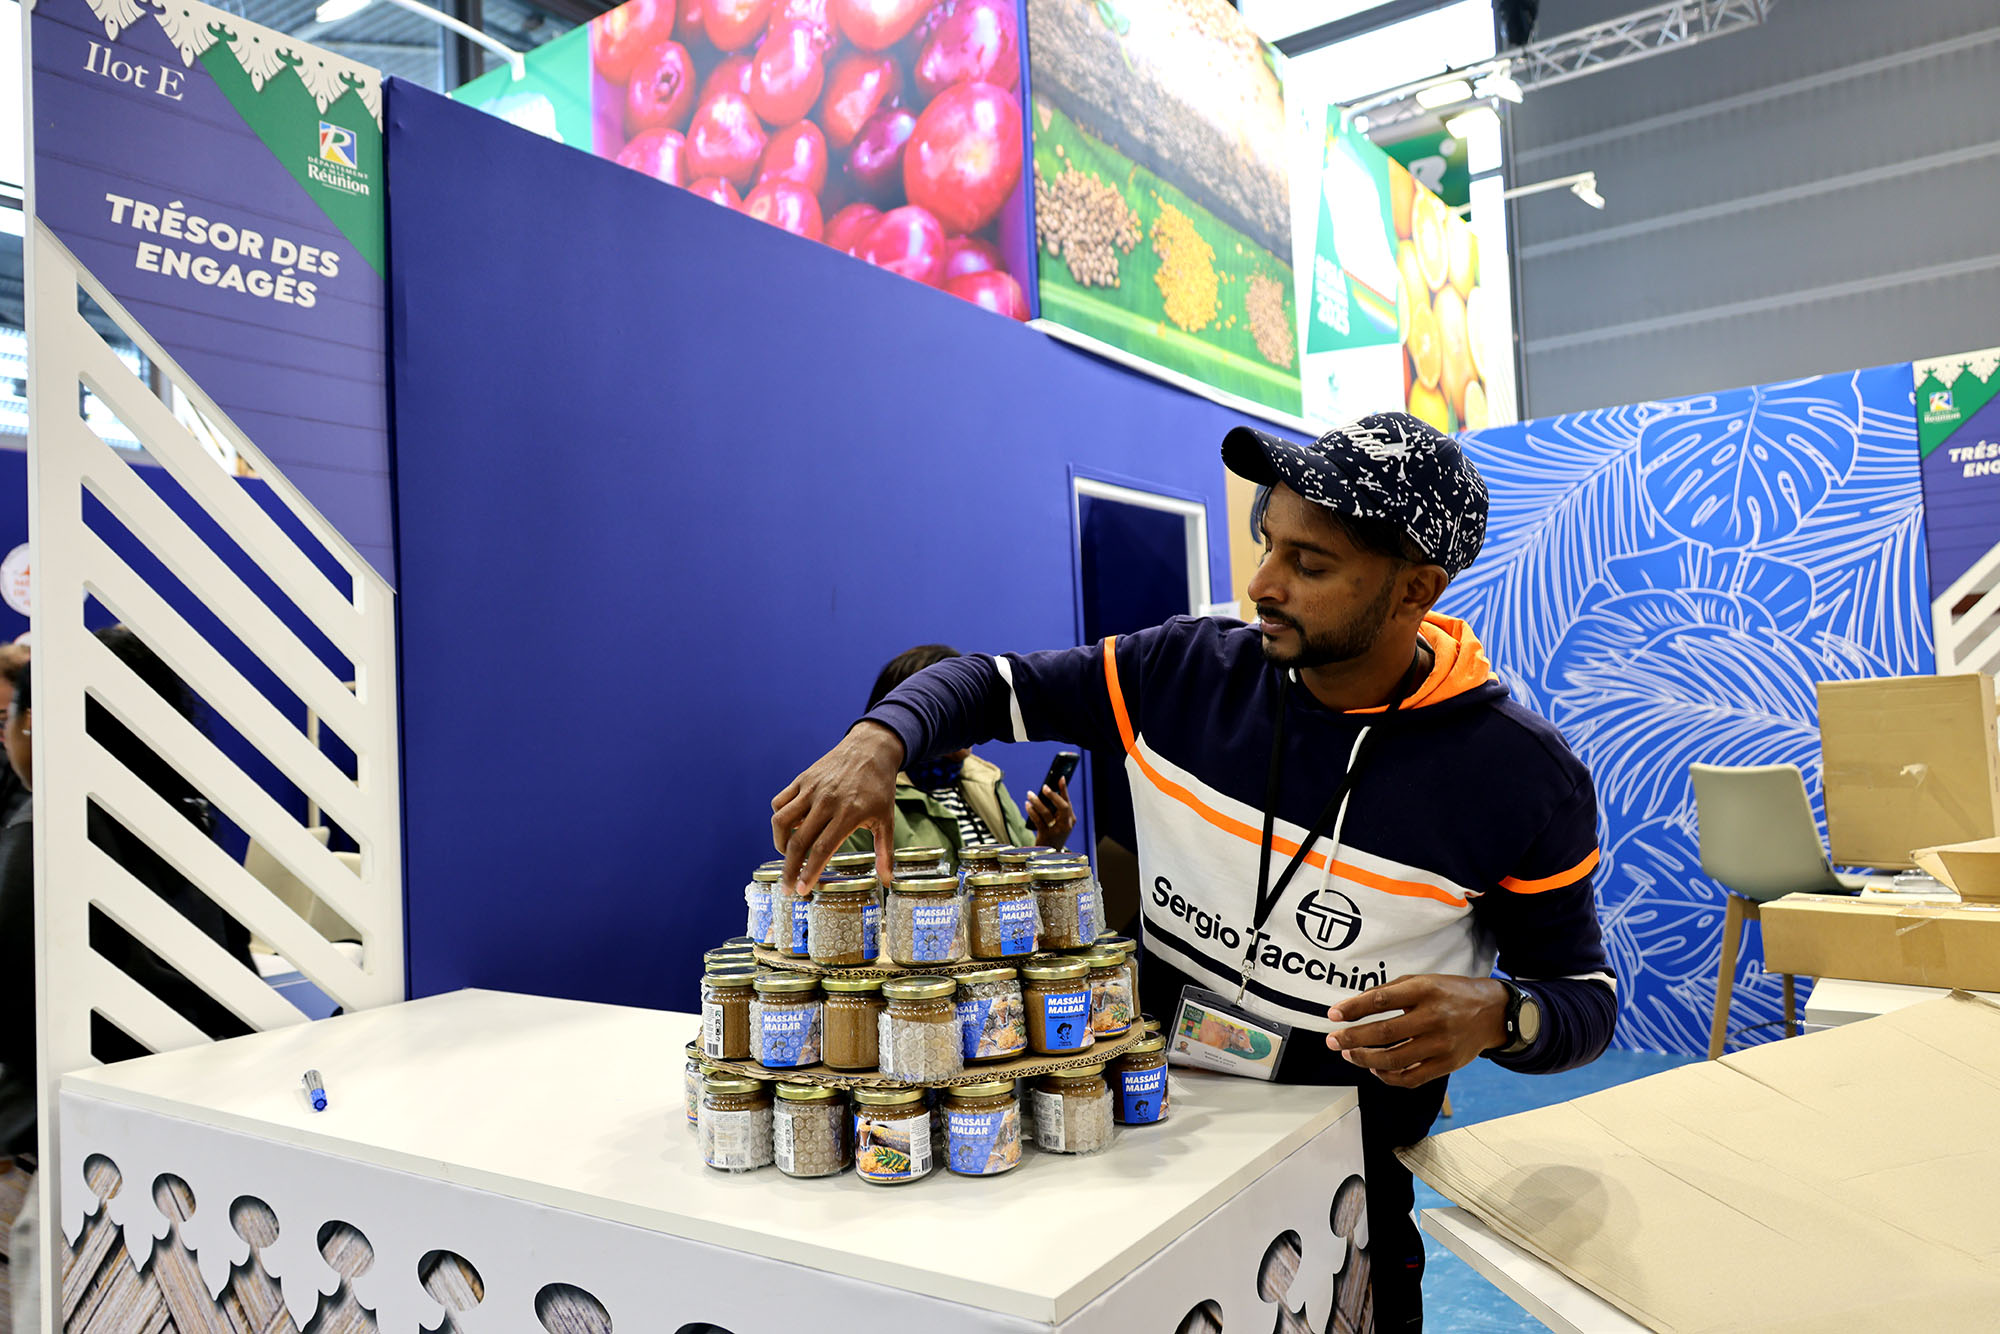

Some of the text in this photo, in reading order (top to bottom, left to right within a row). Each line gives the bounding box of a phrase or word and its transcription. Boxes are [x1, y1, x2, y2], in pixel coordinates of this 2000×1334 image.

[83, 41, 186, 101] Ilot E
[307, 163, 369, 195] Réunion
[105, 192, 340, 279] TRÉSOR DES
[135, 241, 319, 308] ENGAGÉS
[1152, 876, 1240, 949] Sergio
[916, 917, 951, 925] MALBAR
[1048, 993, 1086, 1005] MASSALÉ
[1048, 1004, 1084, 1014] MALBAR
[764, 1013, 804, 1023] MASSALÉ
[764, 1023, 801, 1031] MALBAR
[1125, 1071, 1161, 1084] MASSALÉ
[1126, 1081, 1159, 1092] MALBAR
[950, 1115, 992, 1126] MASSALÉ
[951, 1126, 989, 1136] MALBAR
